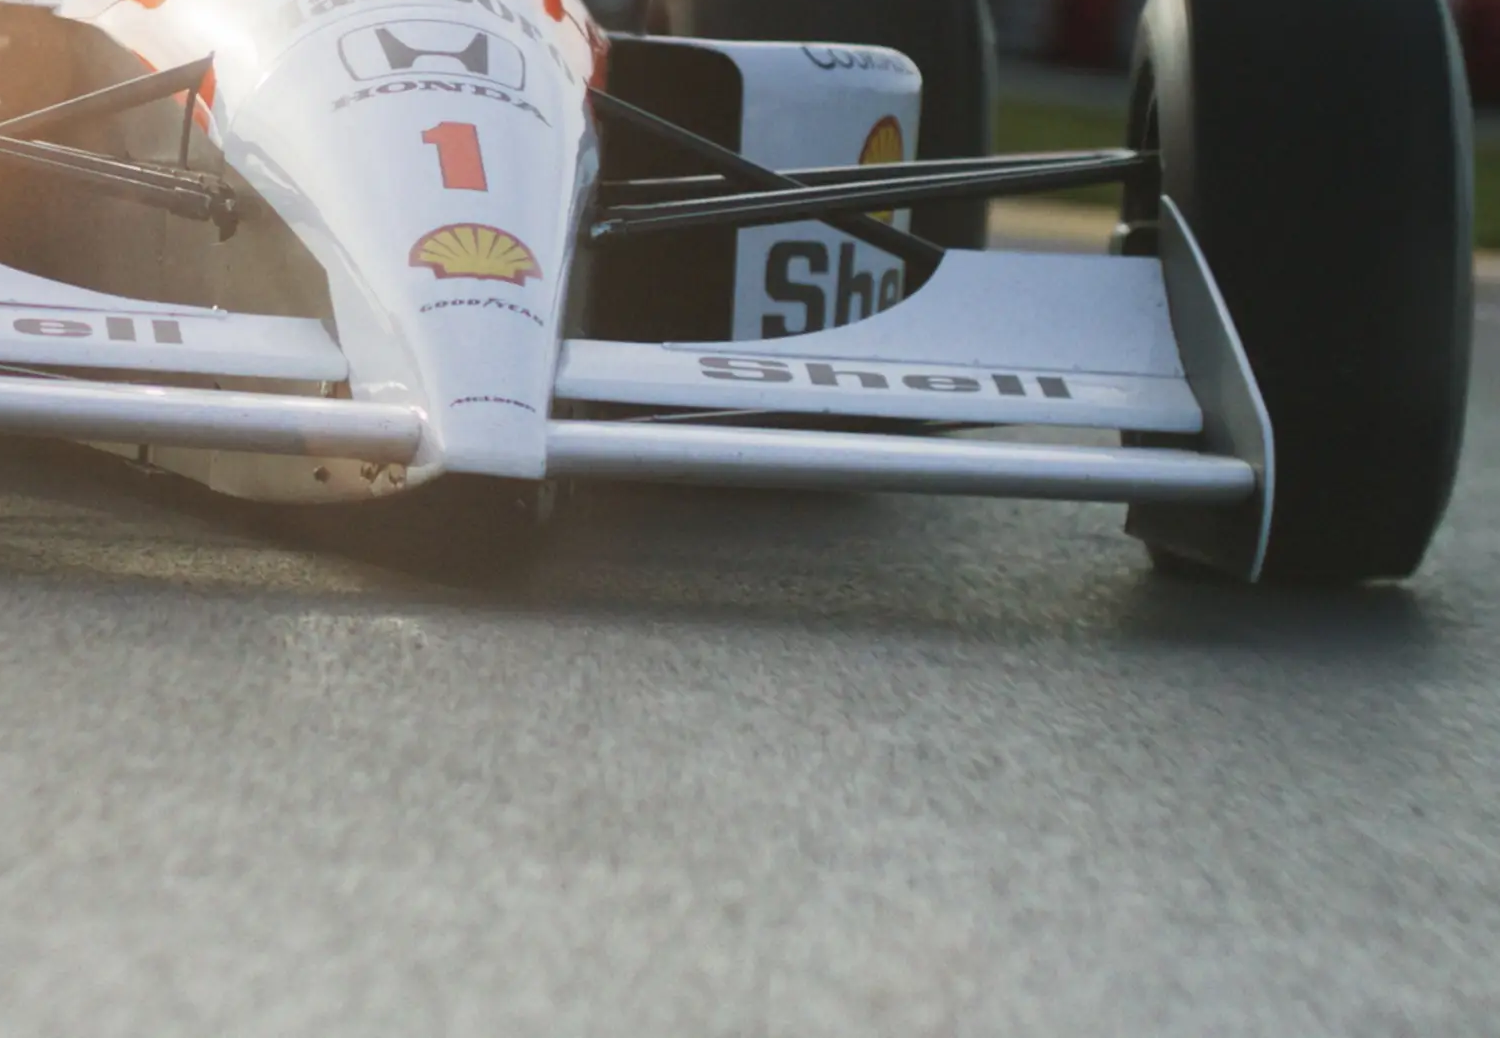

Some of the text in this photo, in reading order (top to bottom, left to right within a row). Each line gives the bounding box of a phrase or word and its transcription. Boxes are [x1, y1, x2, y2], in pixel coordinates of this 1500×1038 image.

[330, 80, 552, 128] HONDA
[420, 121, 488, 192] 1
[699, 356, 1072, 399] Shell
